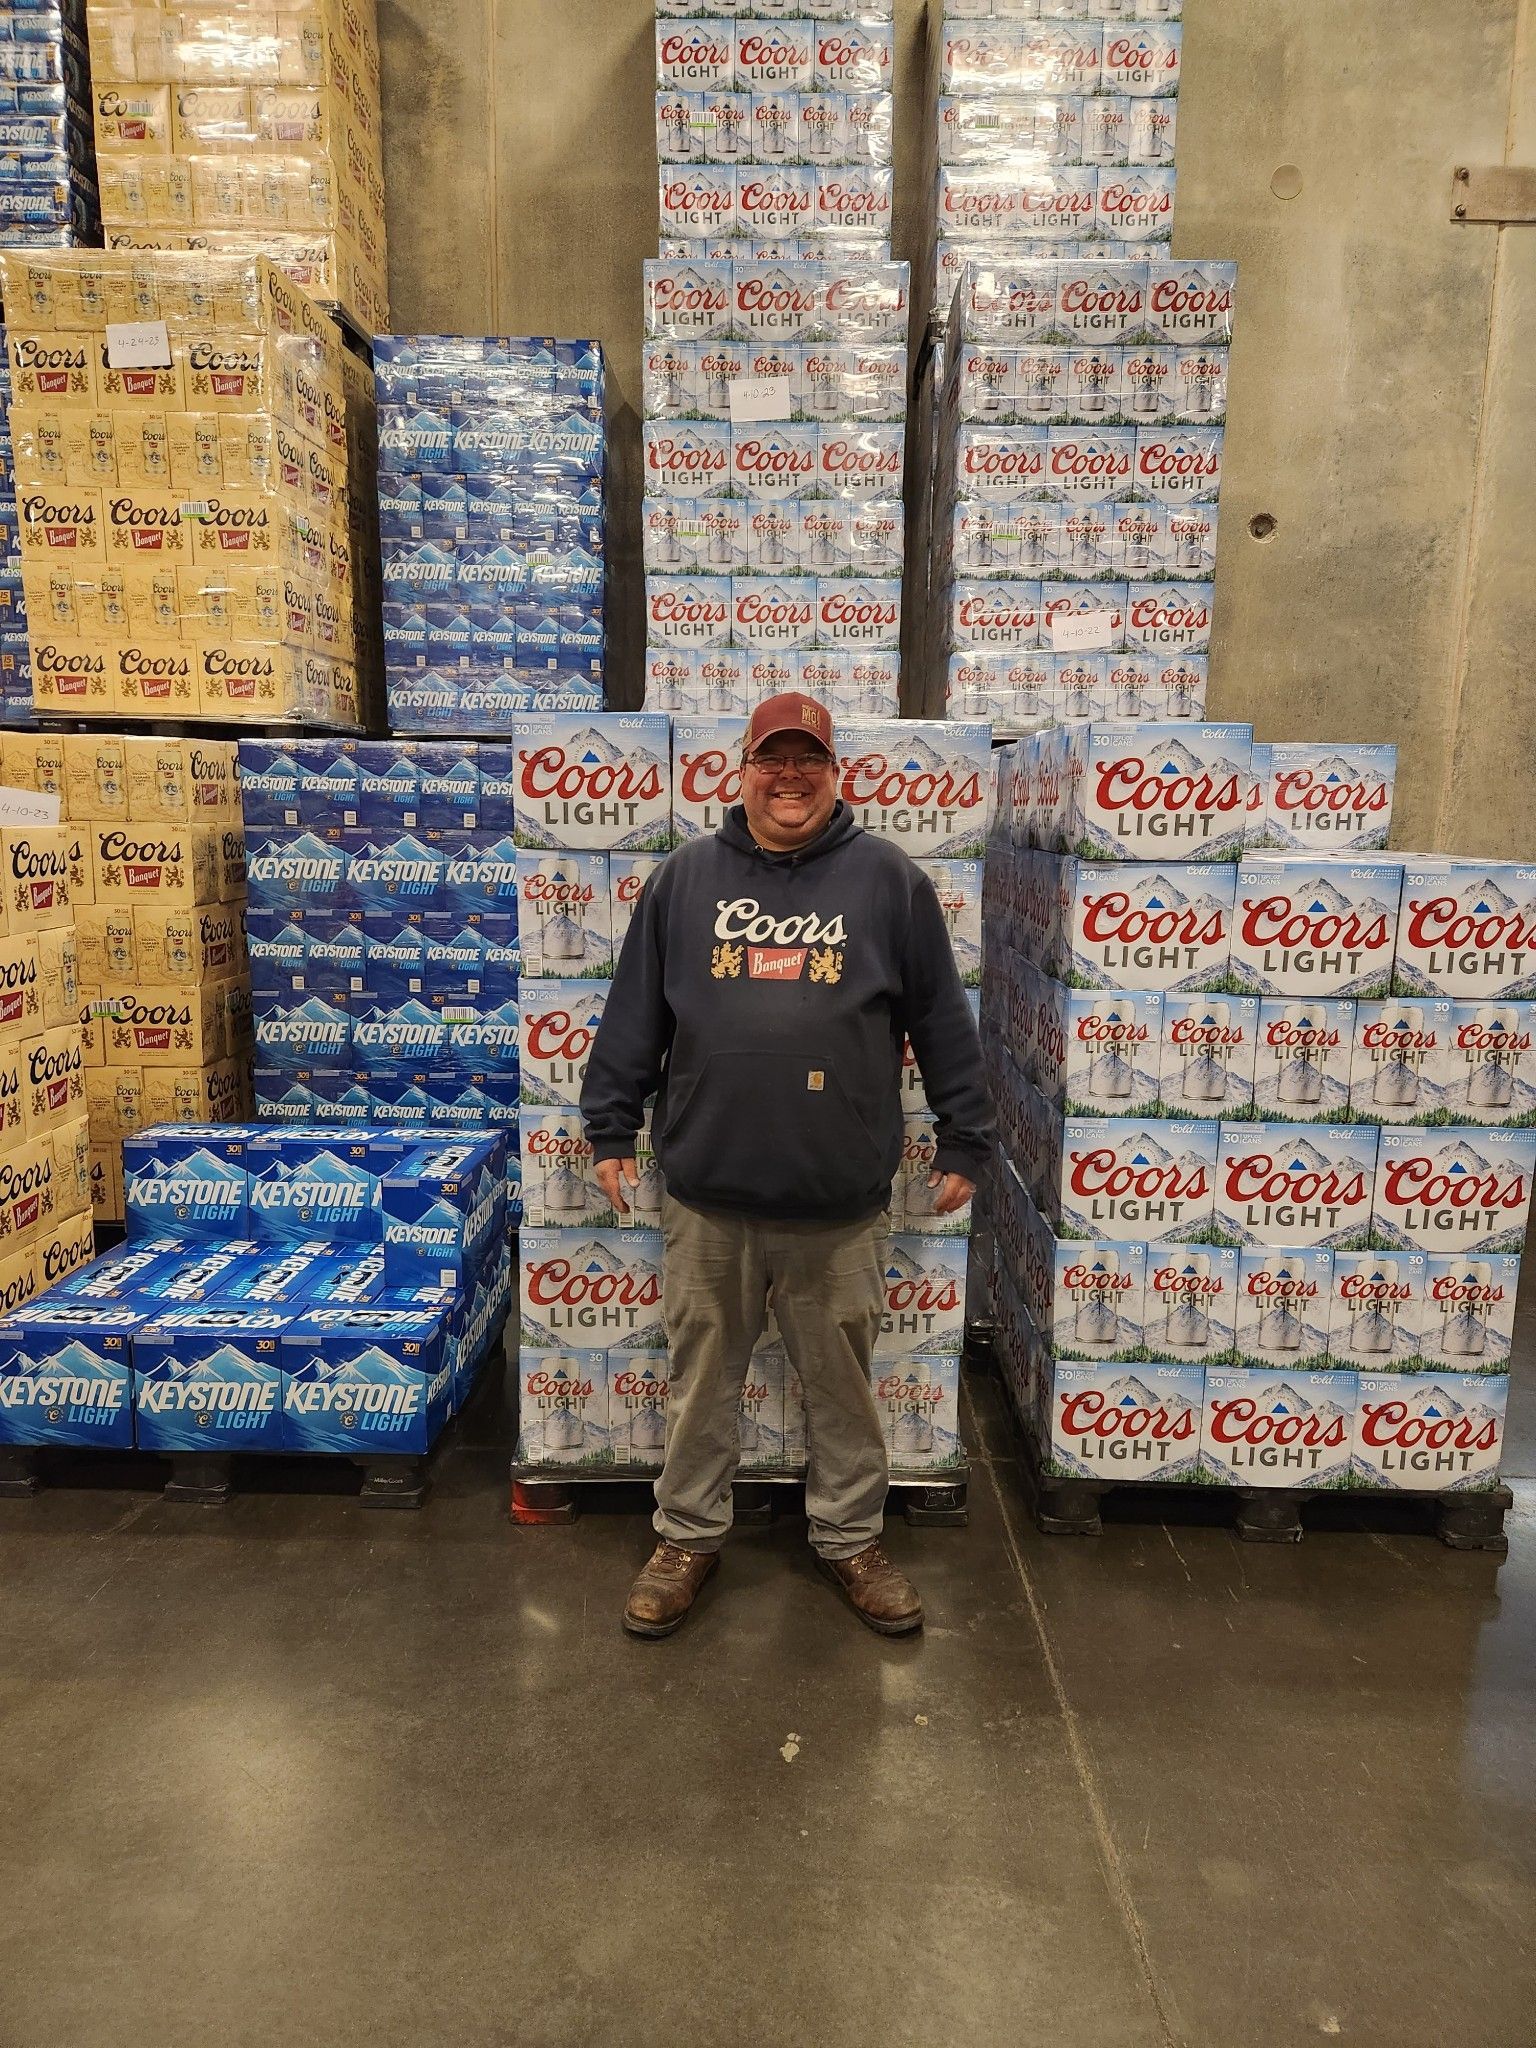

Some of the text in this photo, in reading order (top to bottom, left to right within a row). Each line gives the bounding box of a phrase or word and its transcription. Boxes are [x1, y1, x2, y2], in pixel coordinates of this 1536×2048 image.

[661, 35, 731, 65] Coors
[1103, 39, 1178, 69] Coors
[672, 65, 720, 78] LIGHT
[1117, 70, 1165, 82] LIGHT
[755, 105, 792, 122] Coors
[1100, 184, 1172, 213] Coors
[1111, 213, 1159, 227] LIGHT
[736, 279, 818, 312] Coors
[1061, 280, 1142, 313] Coors
[1149, 280, 1233, 313] Coors
[750, 313, 804, 327] LIGHT
[1074, 314, 1128, 328] LIGHT
[1163, 314, 1217, 328] LIGHT
[14, 340, 88, 368] Coors
[700, 356, 742, 372] Coors
[1127, 359, 1168, 375] Coors
[142, 430, 165, 441] Coors
[379, 431, 452, 449] KEYSTONE
[1139, 444, 1219, 474] Coors
[1151, 476, 1205, 490] LIGHT
[22, 495, 96, 524] Coors
[110, 498, 183, 527] Coors
[380, 499, 421, 513] KEYSTONE
[49, 529, 77, 546] Banquet
[134, 531, 161, 548] Banquet
[383, 562, 454, 582] KEYSTONE
[153, 582, 176, 593] Coors
[423, 579, 450, 591] LIGHT
[736, 594, 813, 624] Coors
[1132, 599, 1208, 628] Coors
[472, 630, 514, 644] KEYSTONE
[749, 624, 800, 638] LIGHT
[1143, 629, 1195, 642] LIGHT
[118, 648, 190, 676] Coors
[203, 648, 275, 676] Coors
[1161, 669, 1200, 683] Coors
[143, 680, 171, 697] Banquet
[229, 680, 256, 698] Banquet
[387, 689, 458, 709] KEYSTONE
[514, 724, 530, 736] 30
[619, 718, 642, 729] Cold
[944, 726, 967, 736] Cold
[1202, 729, 1227, 739] Cold
[1094, 736, 1110, 746] 30
[97, 757, 123, 769] Coors
[190, 750, 227, 780] Coors
[519, 746, 664, 800] Coors
[301, 776, 356, 792] KEYSTONE
[840, 754, 983, 808] Coors
[1096, 758, 1242, 811] Coors
[1275, 769, 1388, 810] Coors
[1, 803, 49, 820] 4-10-23
[544, 802, 639, 825] LIGHT
[863, 809, 957, 834] LIGHT
[1292, 812, 1366, 830] LIGHT
[1118, 813, 1214, 836] LIGHT
[99, 831, 185, 862] Coors
[10, 840, 67, 879] Coors
[248, 858, 343, 880] KEYSTONE
[590, 856, 604, 865] 30
[128, 868, 160, 885] Banquet
[347, 860, 441, 882] KEYSTONE
[1351, 869, 1376, 879] Cold
[301, 881, 338, 892] LIGHT
[400, 882, 437, 895] LIGHT
[524, 874, 595, 901] Coors
[536, 902, 587, 916] LIGHT
[1083, 892, 1226, 945] Coors
[714, 898, 848, 944] Coors
[1242, 896, 1390, 948] Coors
[309, 944, 363, 959] KEYSTONE
[1103, 945, 1200, 969] LIGHT
[1264, 950, 1363, 974] LIGHT
[753, 952, 803, 975] Banquet
[1428, 952, 1526, 975] LIGHT
[111, 996, 193, 1025] Coors
[1435, 1002, 1449, 1012] 30
[256, 1021, 348, 1043] KEYSTONE
[353, 1023, 447, 1045] KEYSTONE
[1078, 1015, 1150, 1041] Coors
[1171, 1018, 1244, 1044] Coors
[1267, 1021, 1341, 1047] Coors
[1363, 1023, 1437, 1049] Coors
[1457, 1024, 1533, 1050] Coors
[139, 1031, 169, 1048] Banquet
[307, 1043, 342, 1055] LIGHT
[1085, 1041, 1140, 1057] LIGHT
[404, 1045, 439, 1057] LIGHT
[1180, 1043, 1235, 1060] LIGHT
[1275, 1046, 1330, 1062] LIGHT
[1371, 1048, 1427, 1064] LIGHT
[1466, 1049, 1521, 1065] LIGHT
[29, 1046, 82, 1084] Coors
[316, 1104, 368, 1118] KEYSTONE
[1171, 1123, 1194, 1134] Cold
[226, 1145, 237, 1154] 30
[527, 1130, 593, 1155] Coors
[538, 1156, 590, 1169] LIGHT
[1070, 1149, 1210, 1199] Coors
[1226, 1154, 1367, 1205] Coors
[1385, 1157, 1526, 1209] Coors
[128, 1179, 246, 1206] KEYSTONE
[251, 1181, 368, 1208] KEYSTONE
[192, 1205, 240, 1220] LIGHT
[316, 1207, 362, 1222] LIGHT
[1092, 1199, 1185, 1222] LIGHT
[1247, 1205, 1341, 1228] LIGHT
[1405, 1208, 1499, 1231] LIGHT
[385, 1225, 458, 1245] KEYSTONE
[43, 1231, 94, 1280] Coors
[427, 1246, 455, 1257] LIGHT
[526, 1259, 662, 1305] Coors
[1063, 1264, 1134, 1290] Coors
[1154, 1268, 1224, 1293] Coors
[1248, 1272, 1319, 1297] Coors
[1340, 1274, 1412, 1299] Coors
[884, 1277, 960, 1312] ors
[1071, 1289, 1125, 1304] LIGHT
[1162, 1292, 1216, 1307] LIGHT
[1432, 1276, 1505, 1301] Coors
[1256, 1296, 1309, 1311] LIGHT
[1347, 1298, 1402, 1314] LIGHT
[1440, 1300, 1495, 1315] LIGHT
[550, 1307, 638, 1328] LIGHT
[527, 1372, 594, 1398] Coors
[878, 1375, 945, 1400] Coors
[139, 1381, 279, 1414] KEYSTONE
[286, 1382, 423, 1415] KEYSTONE
[537, 1397, 588, 1411] LIGHT
[888, 1401, 937, 1414] LIGHT
[69, 1405, 119, 1426] LIGHT
[216, 1411, 271, 1429] LIGHT
[361, 1412, 414, 1432] LIGHT
[1061, 1391, 1196, 1440] Coors
[1211, 1398, 1347, 1447] Coors
[1361, 1401, 1498, 1450] Coors
[1081, 1438, 1171, 1461] LIGHT
[1231, 1447, 1322, 1469] LIGHT
[1382, 1450, 1474, 1472] LIGHT
